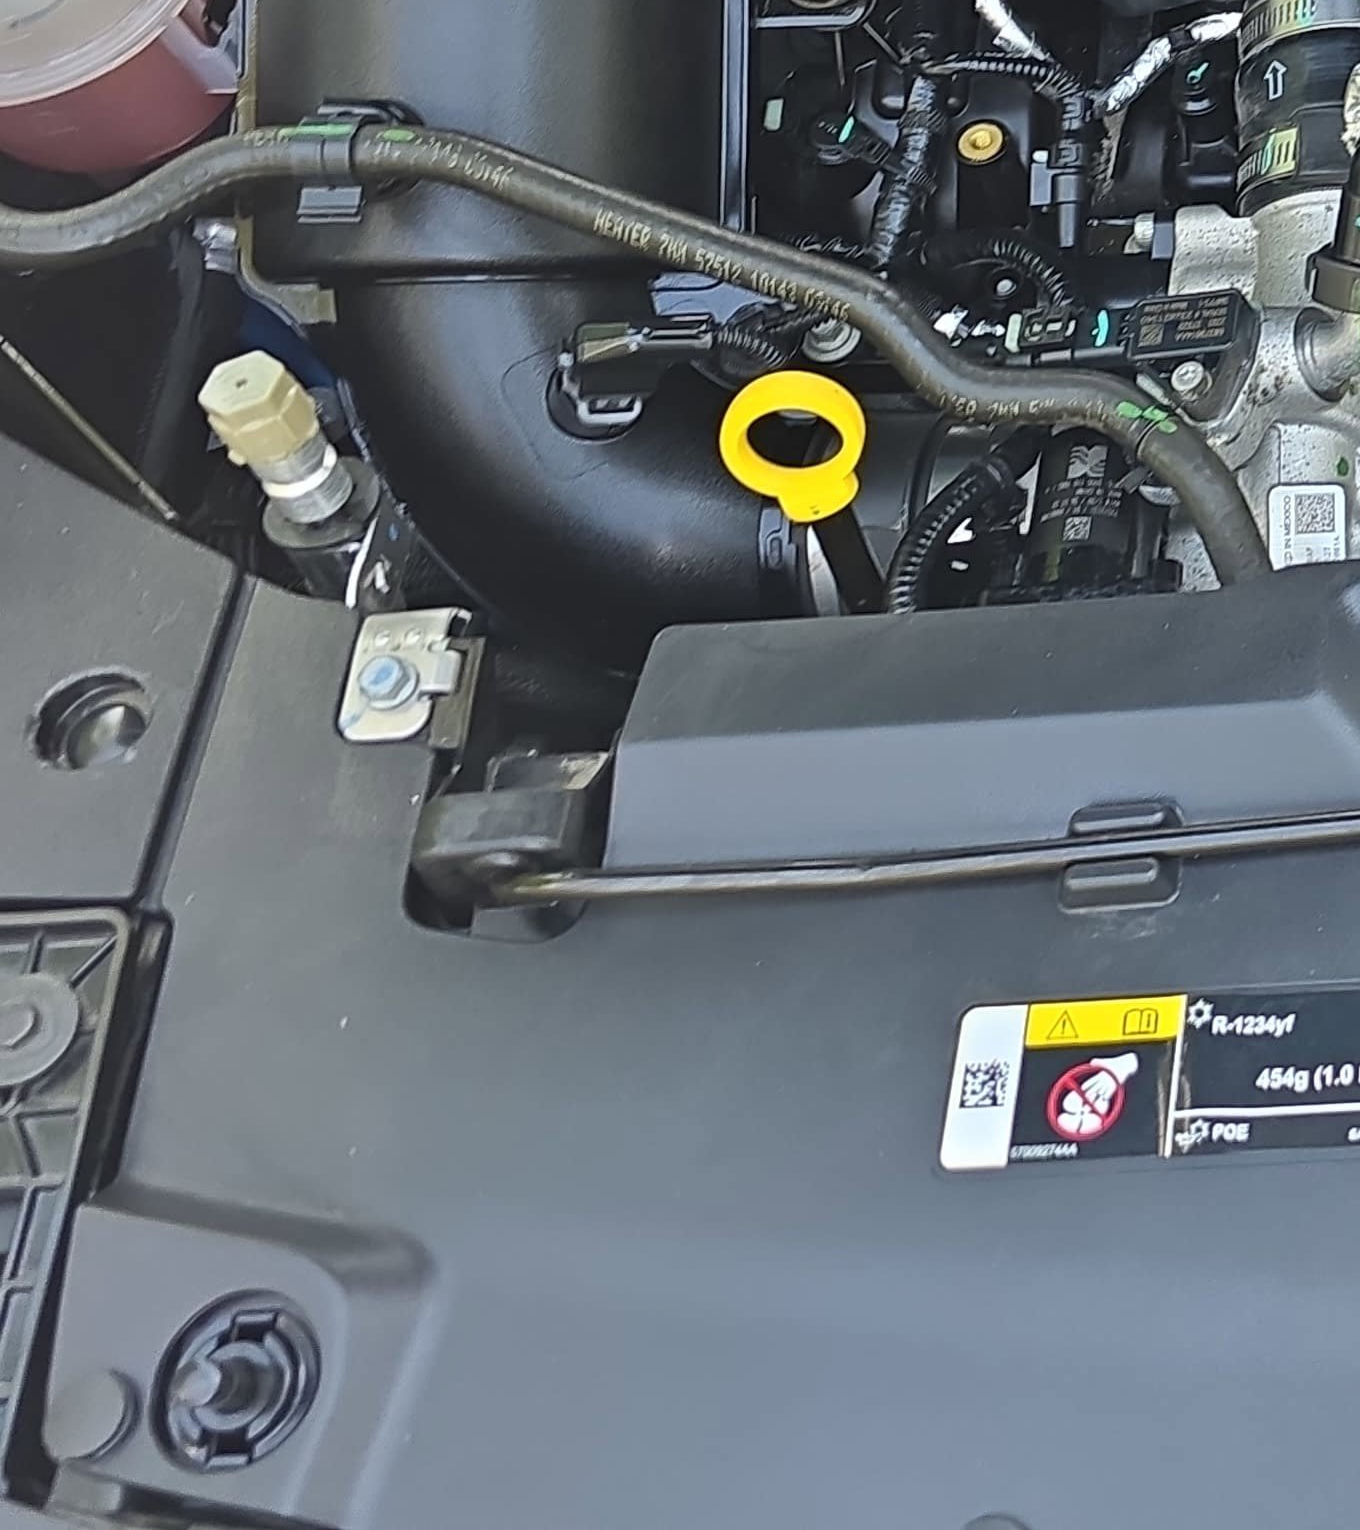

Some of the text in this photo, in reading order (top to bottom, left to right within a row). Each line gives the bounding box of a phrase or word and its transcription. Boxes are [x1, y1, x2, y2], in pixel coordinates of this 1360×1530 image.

[594, 208, 650, 251] HEATER
[1211, 1012, 1295, 1036] R-1234yf
[1255, 1064, 1309, 1092] 454g
[1313, 1062, 1354, 1091] (1.0
[1211, 1123, 1249, 1142] POE
